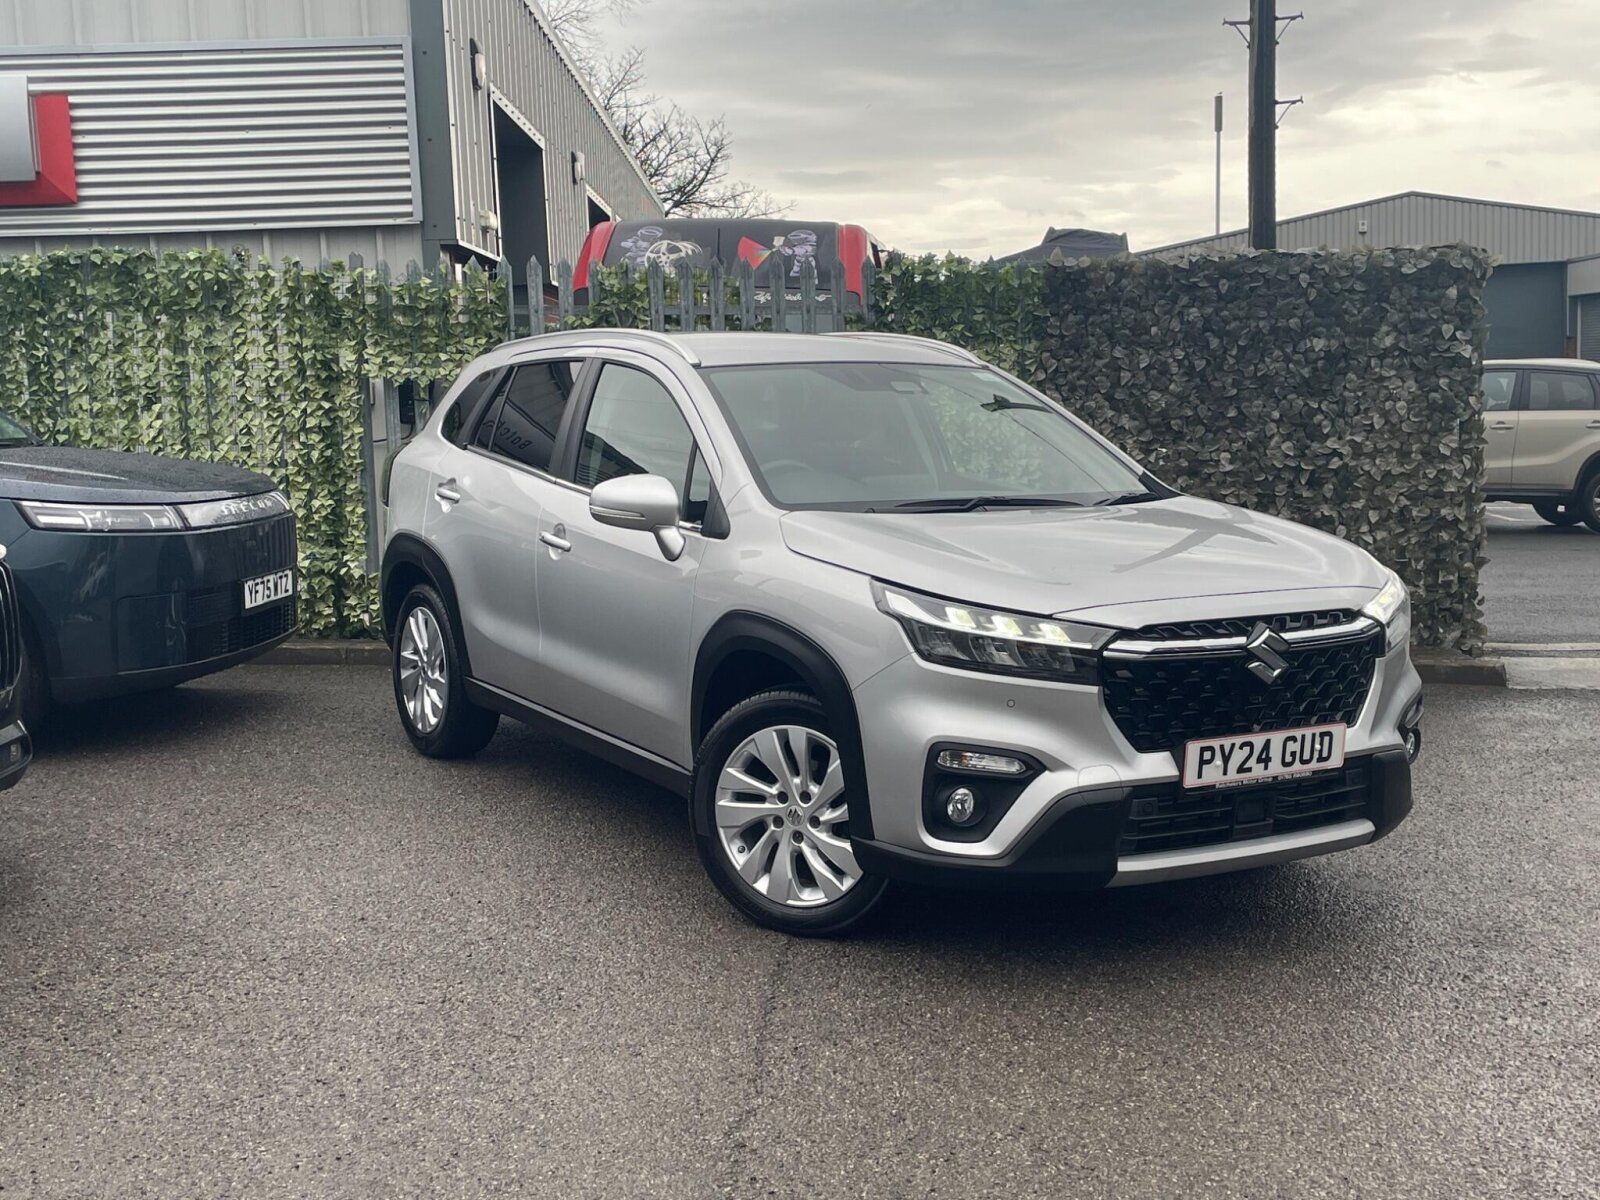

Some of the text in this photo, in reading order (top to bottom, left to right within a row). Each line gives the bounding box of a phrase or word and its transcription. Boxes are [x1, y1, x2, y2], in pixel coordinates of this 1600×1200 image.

[247, 579, 272, 605] YF75
[1197, 730, 1334, 780] PY24 GUD
